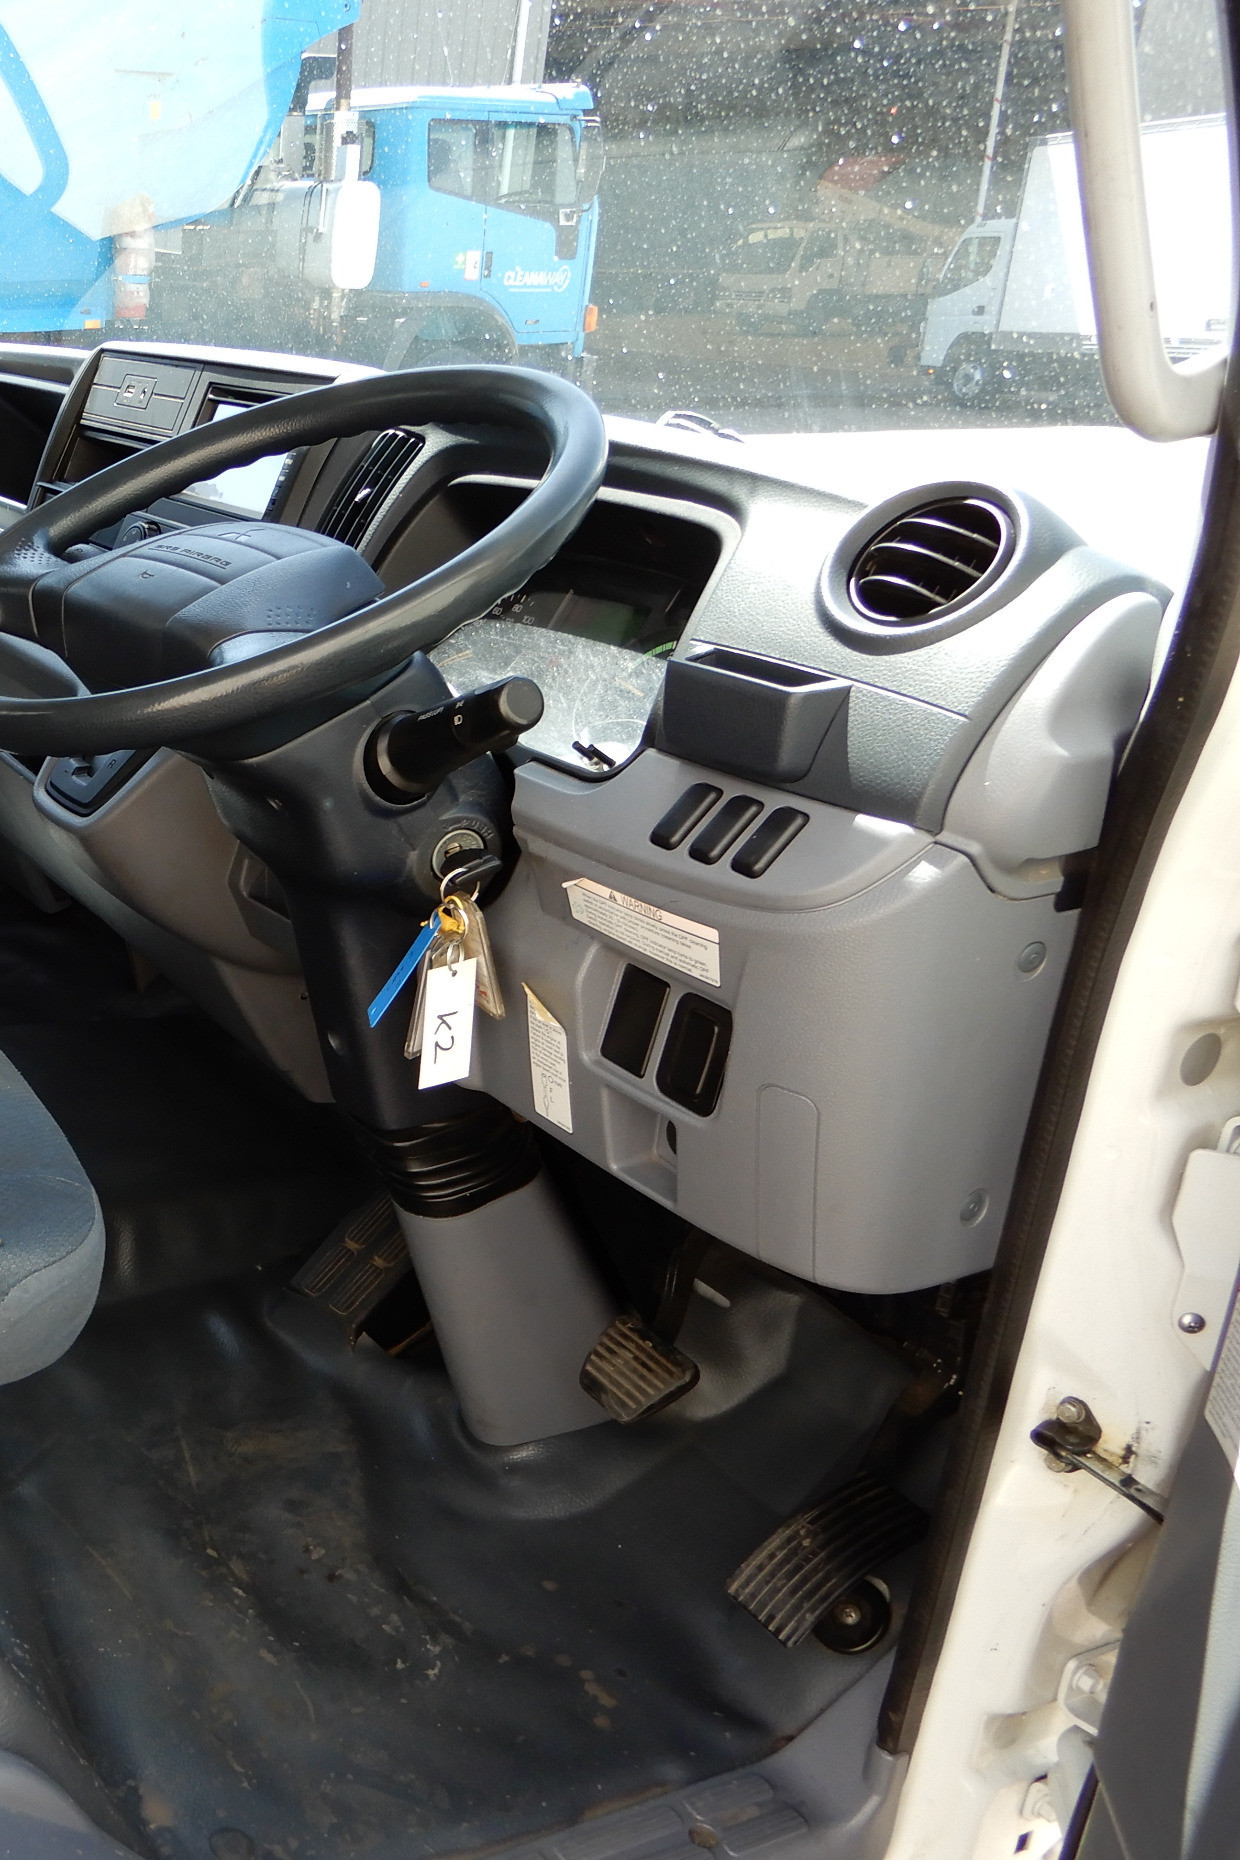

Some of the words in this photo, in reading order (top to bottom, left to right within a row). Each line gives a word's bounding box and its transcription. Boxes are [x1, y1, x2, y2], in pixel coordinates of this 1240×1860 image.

[503, 267, 571, 291] CLEANAWAY
[181, 548, 232, 567] AIRBAG
[511, 603, 523, 613] 80
[522, 615, 535, 625] 100
[107, 758, 117, 769] R
[620, 894, 663, 921] WARNING
[433, 1010, 459, 1064] K2
